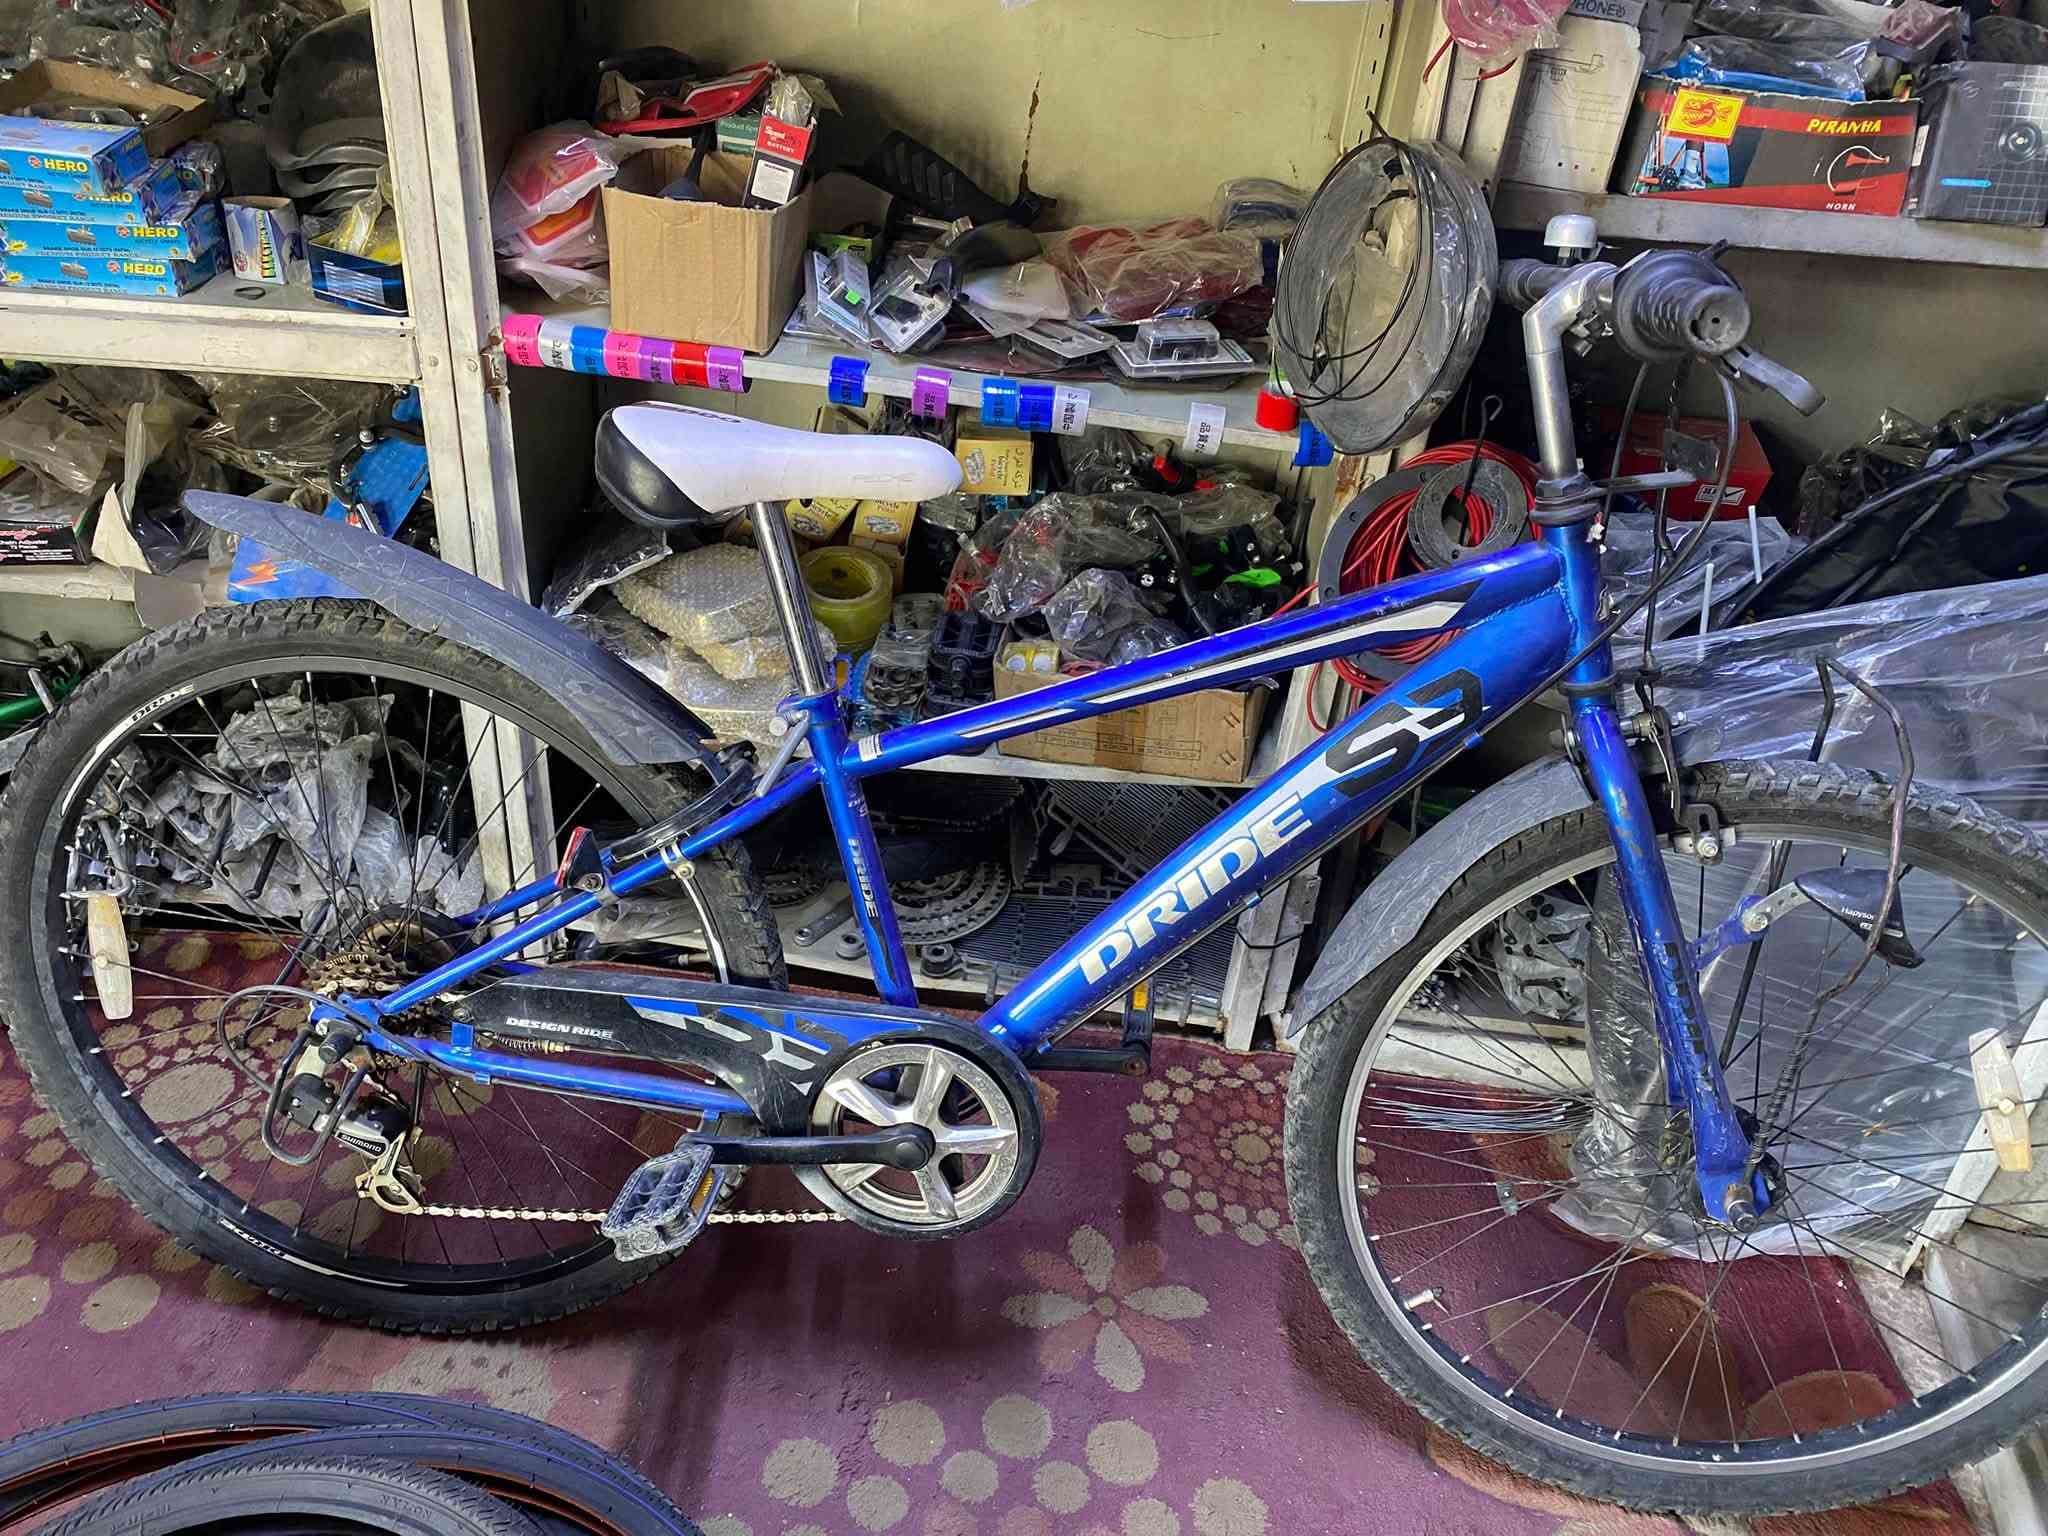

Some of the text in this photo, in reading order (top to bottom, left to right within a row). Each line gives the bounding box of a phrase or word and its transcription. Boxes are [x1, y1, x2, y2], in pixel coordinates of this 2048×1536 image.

[1806, 118, 1882, 134] PIRANHA
[43, 158, 88, 173] HERO
[1825, 202, 1857, 211] HORN
[132, 226, 179, 239] HERO
[123, 262, 166, 276] HERO
[1063, 391, 1078, 431] 中国製で
[505, 1016, 614, 1039] DESIGN RIDE
[340, 1133, 382, 1153] SHIMANO
